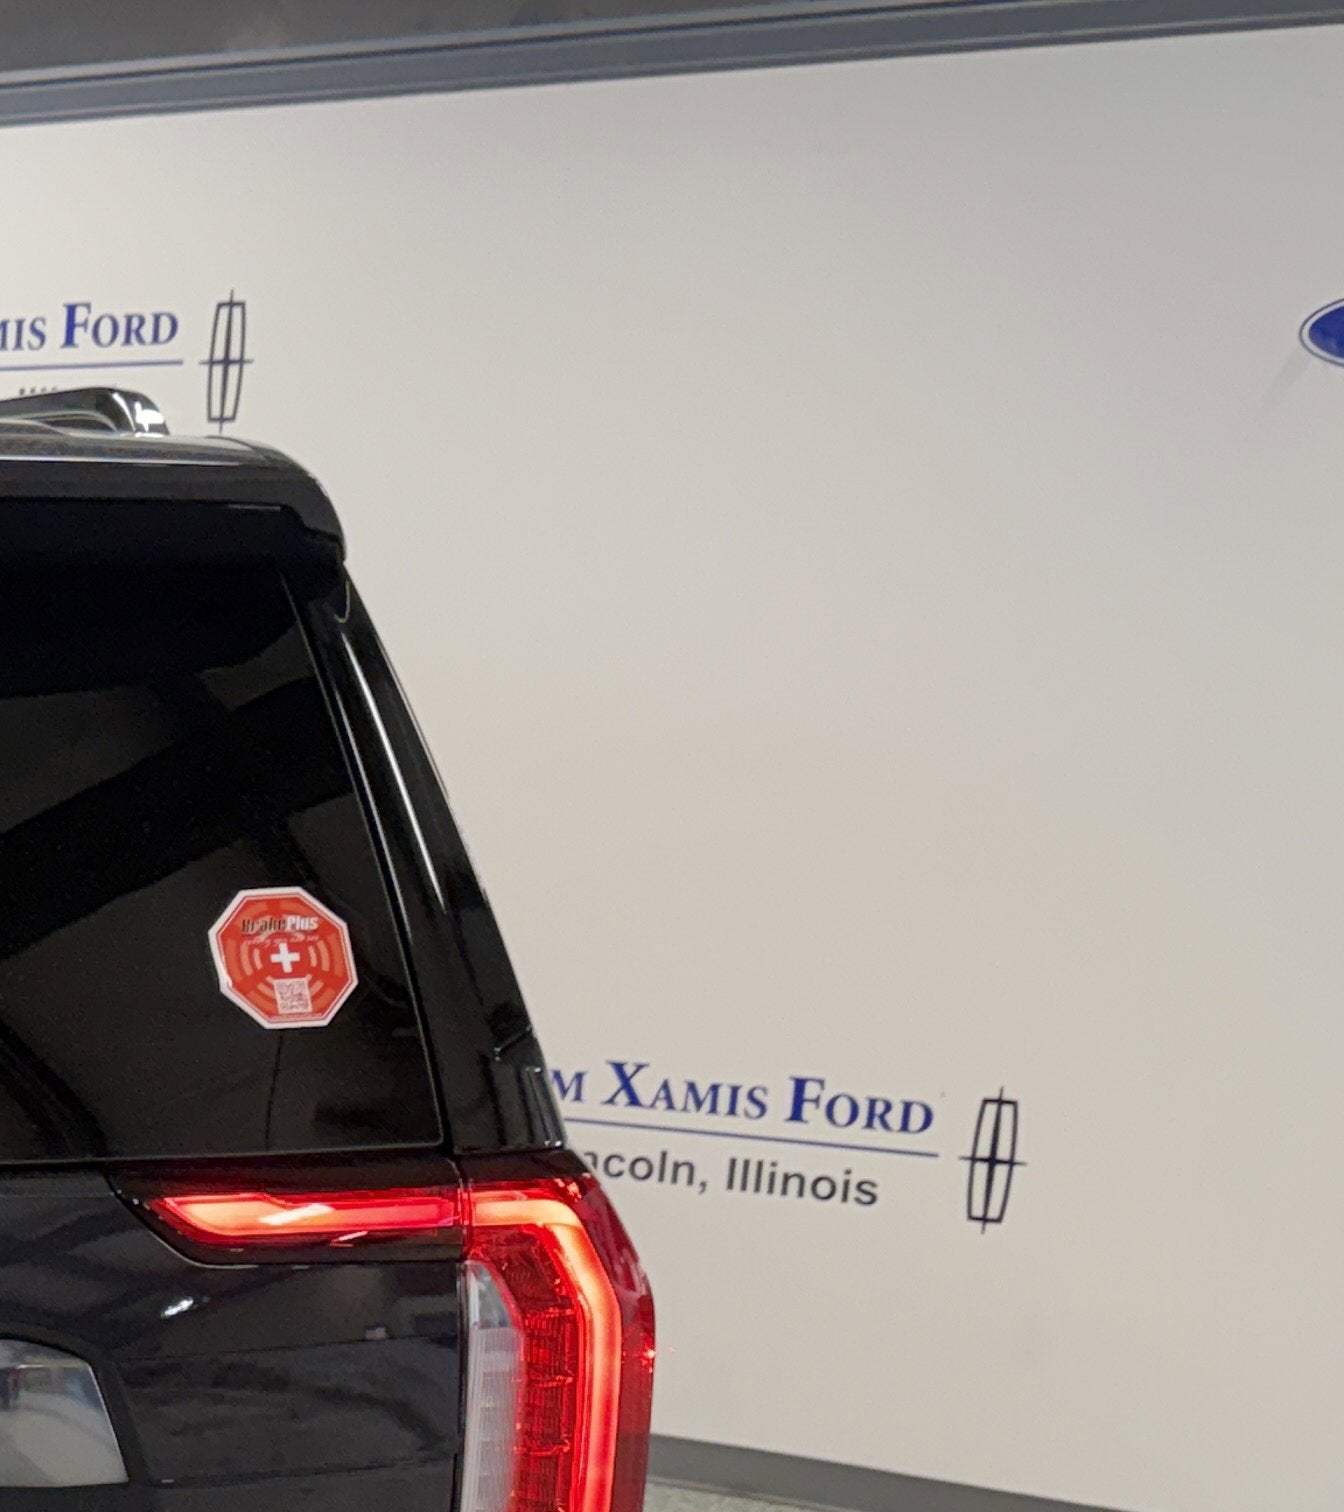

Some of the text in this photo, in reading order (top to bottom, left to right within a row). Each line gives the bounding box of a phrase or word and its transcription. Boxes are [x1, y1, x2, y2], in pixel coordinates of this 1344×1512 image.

[61, 302, 179, 350] FORD
[600, 1060, 769, 1120] XAMIS
[785, 1075, 934, 1135] FORD
[726, 1158, 879, 1206] Illinois
